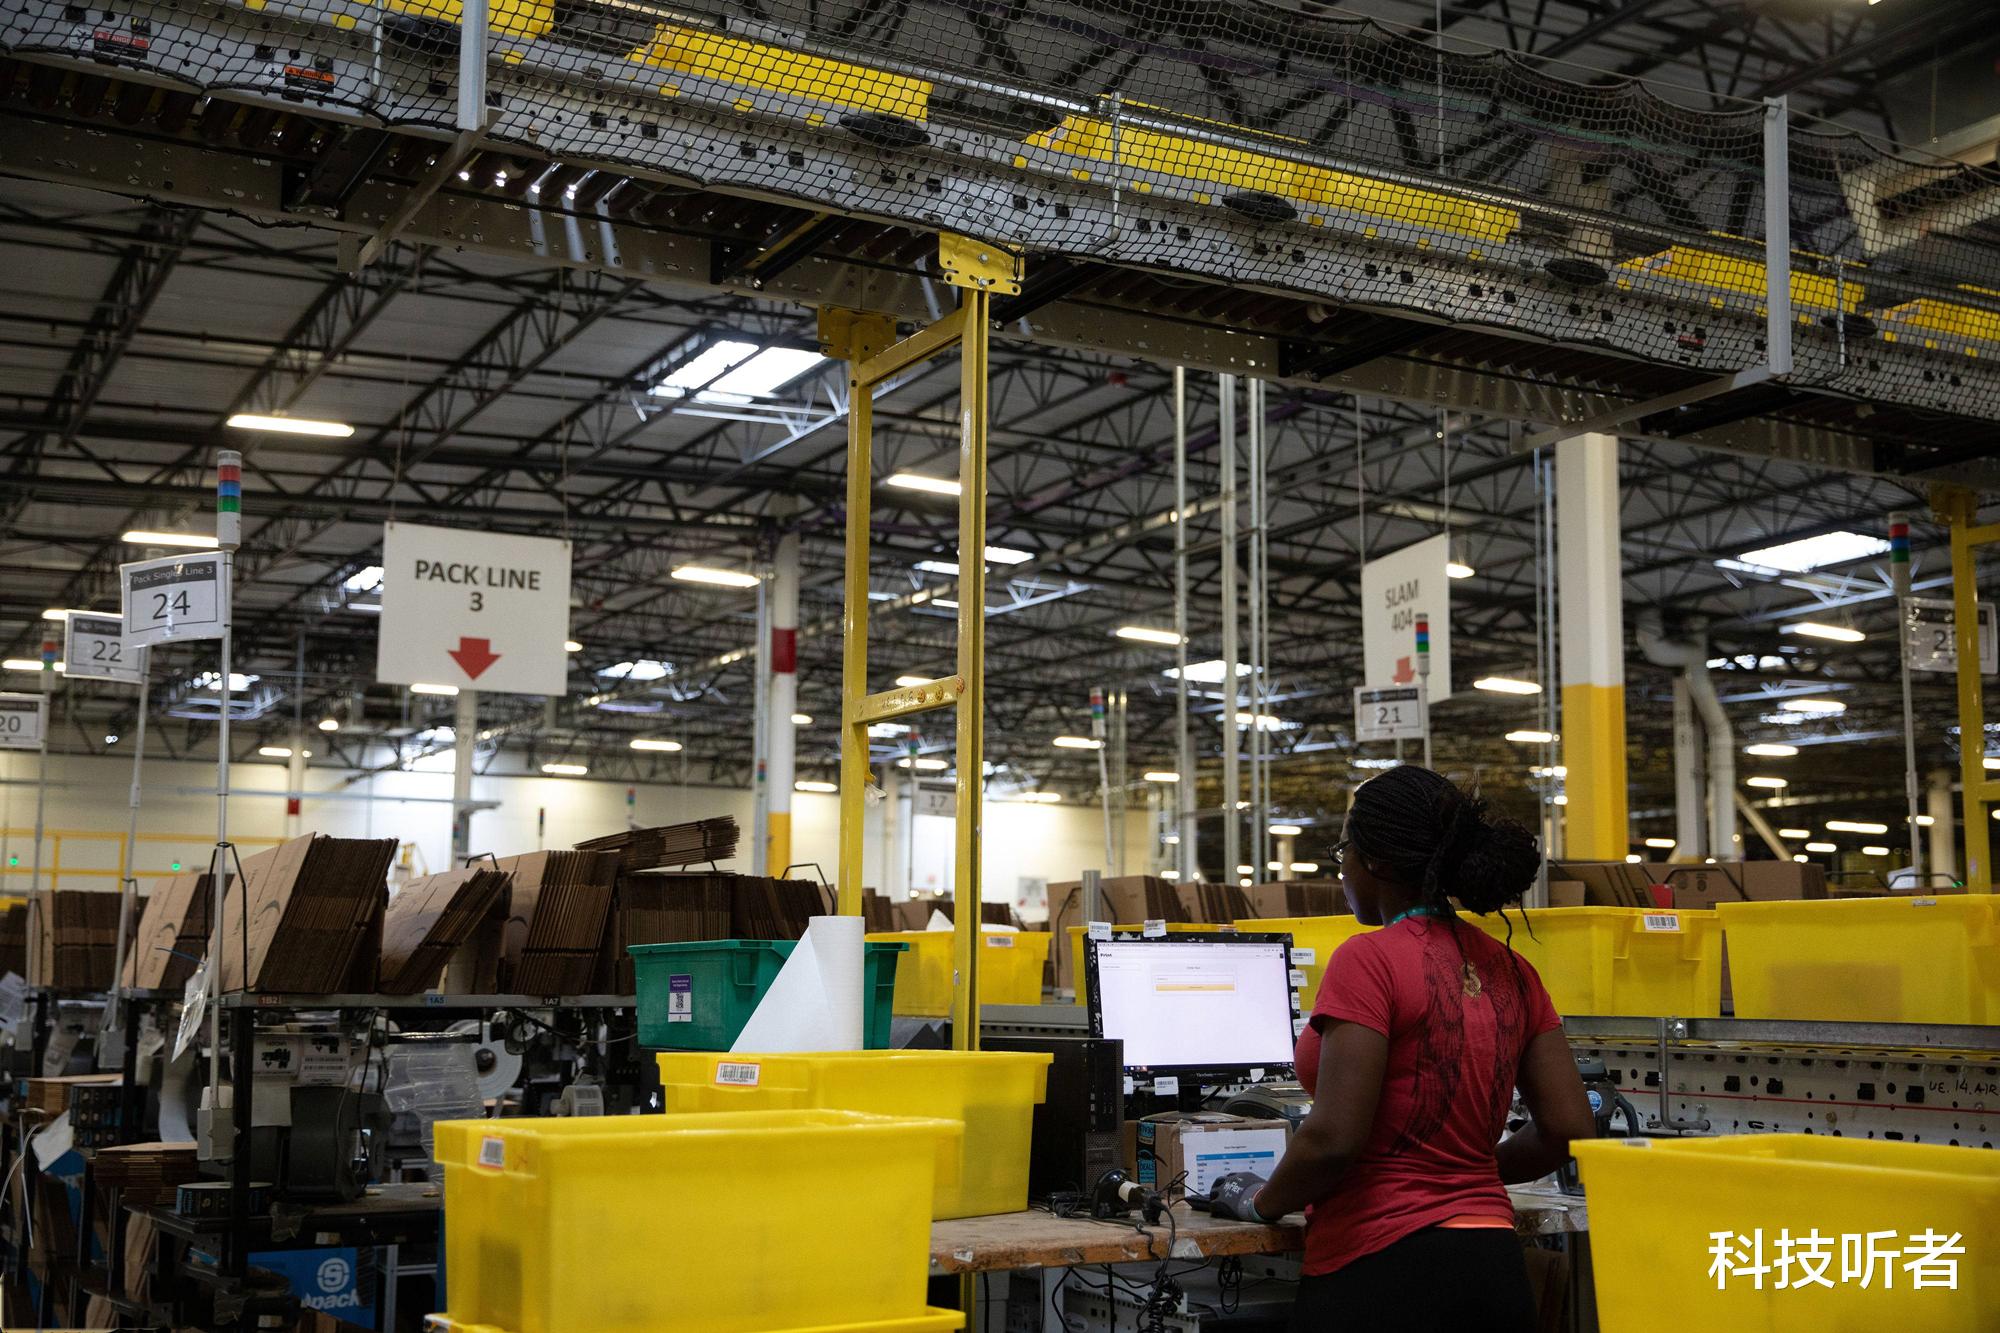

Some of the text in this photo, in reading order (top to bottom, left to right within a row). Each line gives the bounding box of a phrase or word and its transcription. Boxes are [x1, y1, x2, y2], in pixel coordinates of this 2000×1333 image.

[185, 567, 205, 577] Line
[206, 565, 213, 574] 3
[415, 559, 541, 591] PACK LINE
[152, 590, 191, 620] 24
[469, 591, 484, 612] 3
[1385, 578, 1419, 609] SLAM
[1391, 607, 1413, 632] 404
[92, 640, 122, 663] 22
[1377, 706, 1403, 724] 21
[930, 795, 947, 808] 17
